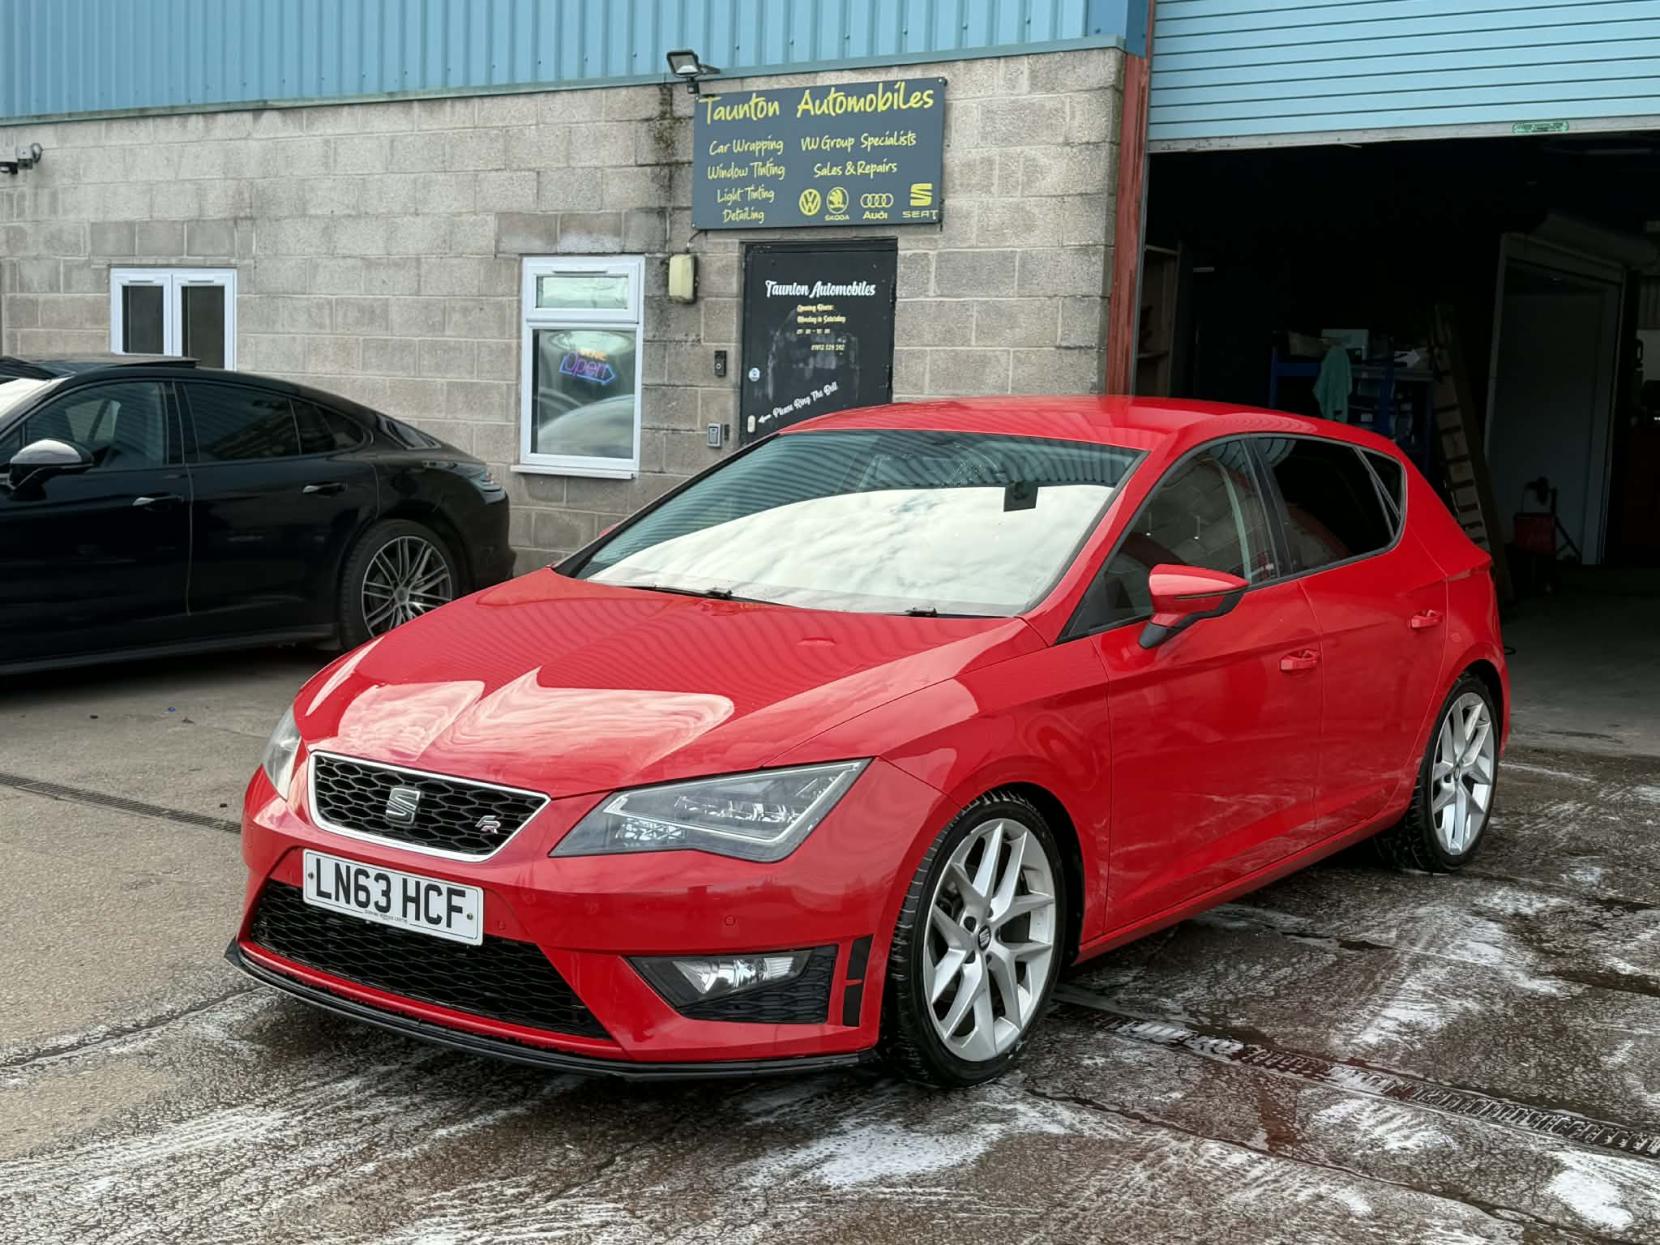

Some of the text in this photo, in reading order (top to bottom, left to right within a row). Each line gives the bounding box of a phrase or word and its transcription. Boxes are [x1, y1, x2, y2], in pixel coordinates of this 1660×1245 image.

[698, 81, 934, 125] Taunton Automobiles
[709, 134, 784, 157] Car Wrapping
[801, 130, 917, 152] VW Group Specialists
[707, 157, 785, 180] Window Tinting
[814, 158, 897, 179] Sales & Repairs
[717, 184, 775, 206] Light Tinting
[722, 206, 765, 224] Detailing
[902, 209, 938, 219] SEAT
[765, 280, 876, 298] Taunton Automobiles
[316, 858, 466, 928] LN63 HCF
